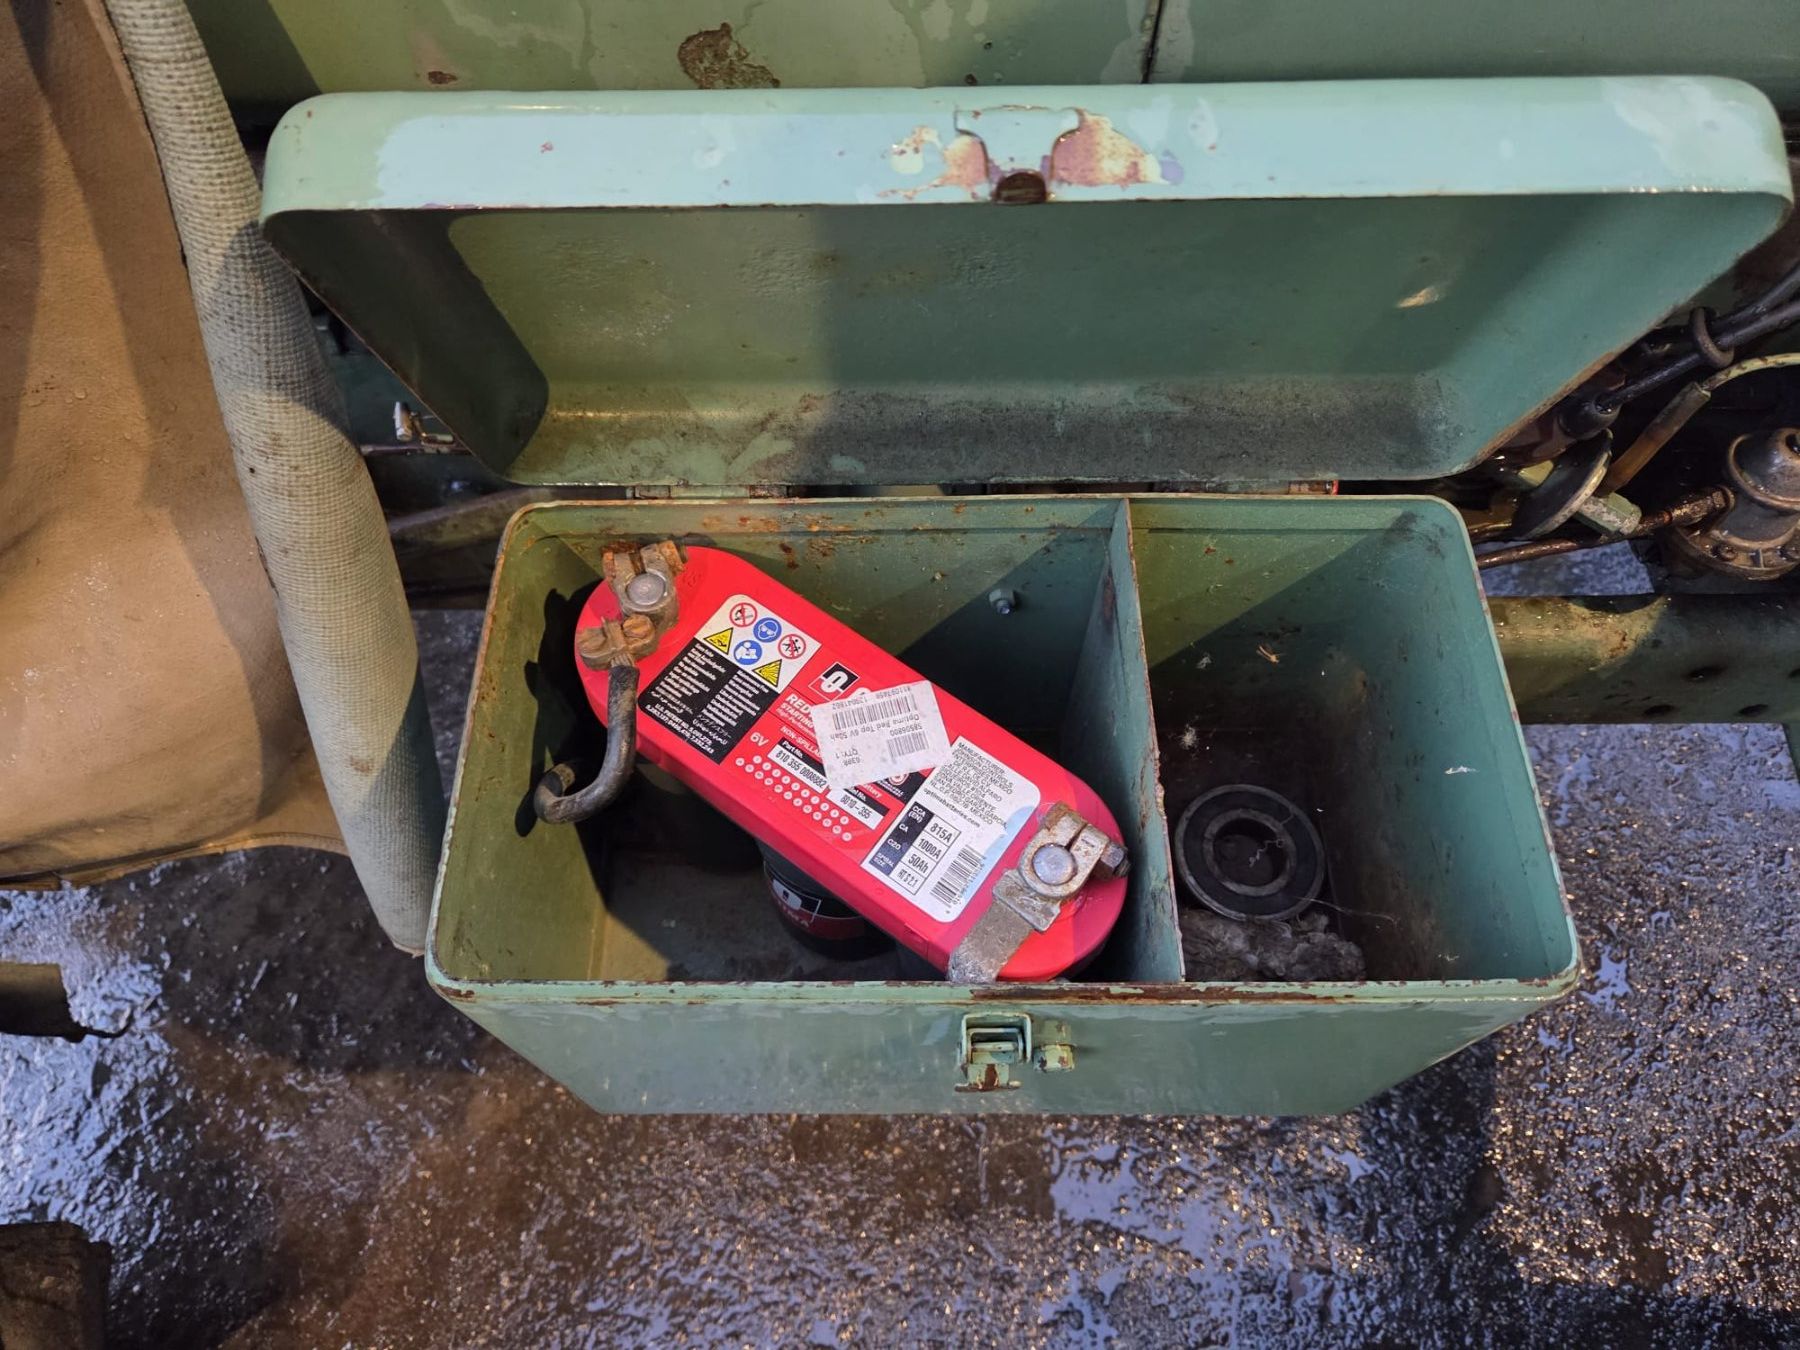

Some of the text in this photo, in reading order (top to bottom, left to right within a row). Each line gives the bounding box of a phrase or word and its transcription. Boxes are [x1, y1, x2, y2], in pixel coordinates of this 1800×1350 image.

[859, 724, 873, 734] Top
[876, 719, 890, 731] Red
[748, 730, 769, 748] 6V
[781, 740, 795, 752] Part
[775, 749, 789, 762] 810
[787, 758, 802, 771] 355
[981, 764, 1013, 788] CONTROLS
[936, 770, 996, 812] ZONA VALLE ORIENTE
[944, 783, 965, 799] PEDRO
[961, 773, 979, 787] DAVID
[978, 784, 1002, 802] ALFARO
[988, 777, 1012, 795] MEXICO
[911, 804, 926, 818] CCA
[922, 787, 981, 828] optimabatteries.com
[898, 822, 909, 832] CA
[928, 821, 953, 843] 815A
[916, 837, 942, 859] 1000A
[907, 853, 930, 873] 50Ah
